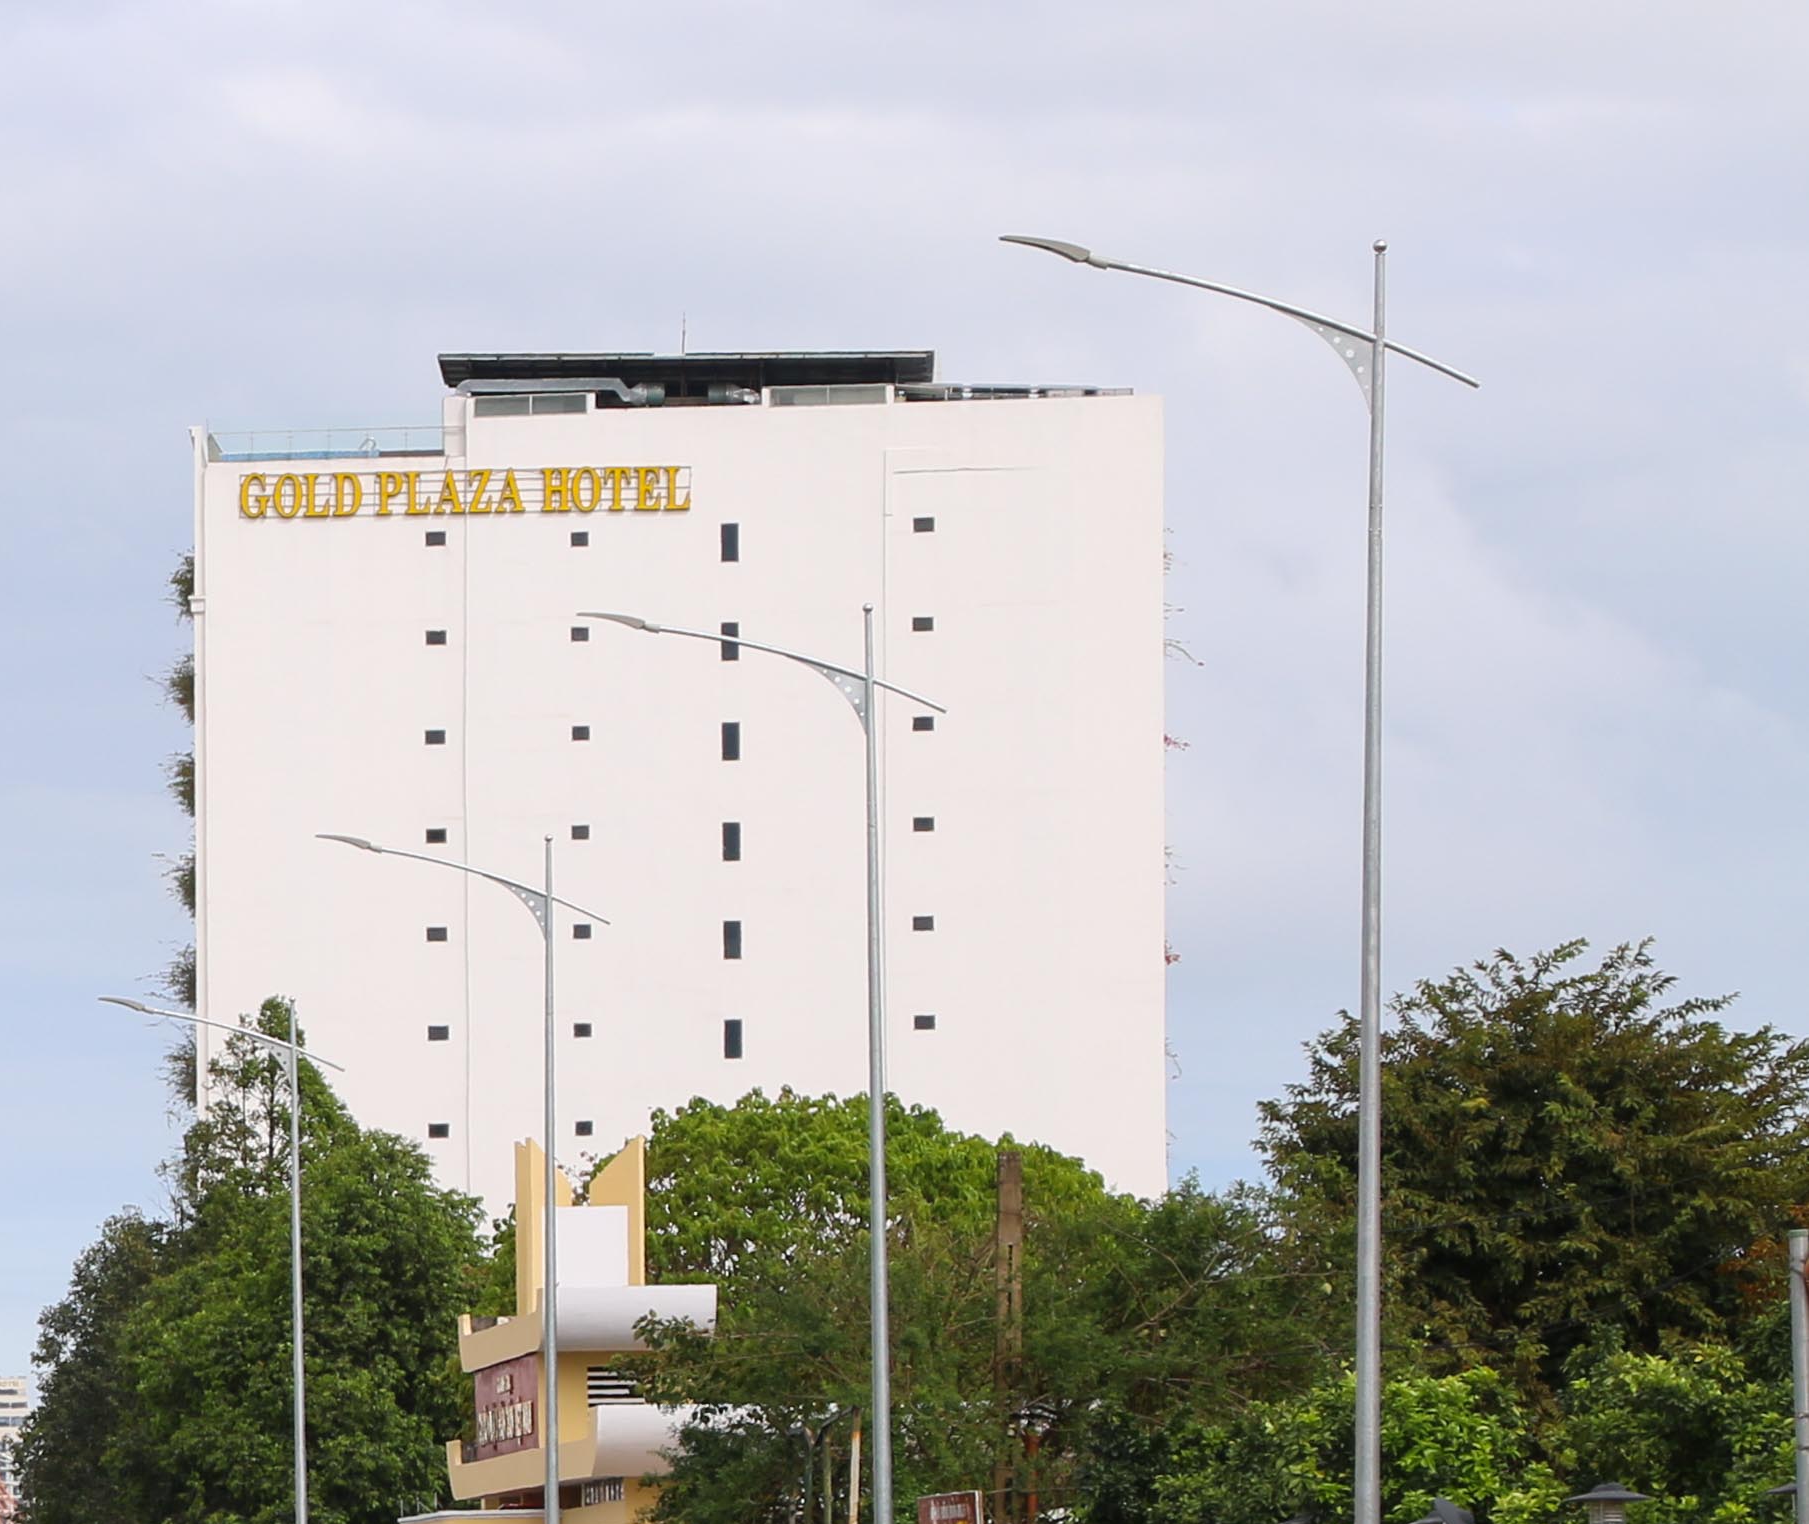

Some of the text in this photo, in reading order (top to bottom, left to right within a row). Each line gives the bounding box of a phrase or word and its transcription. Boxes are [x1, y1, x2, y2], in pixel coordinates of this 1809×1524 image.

[240, 466, 691, 519] GOLD PLAZA HOTEL
